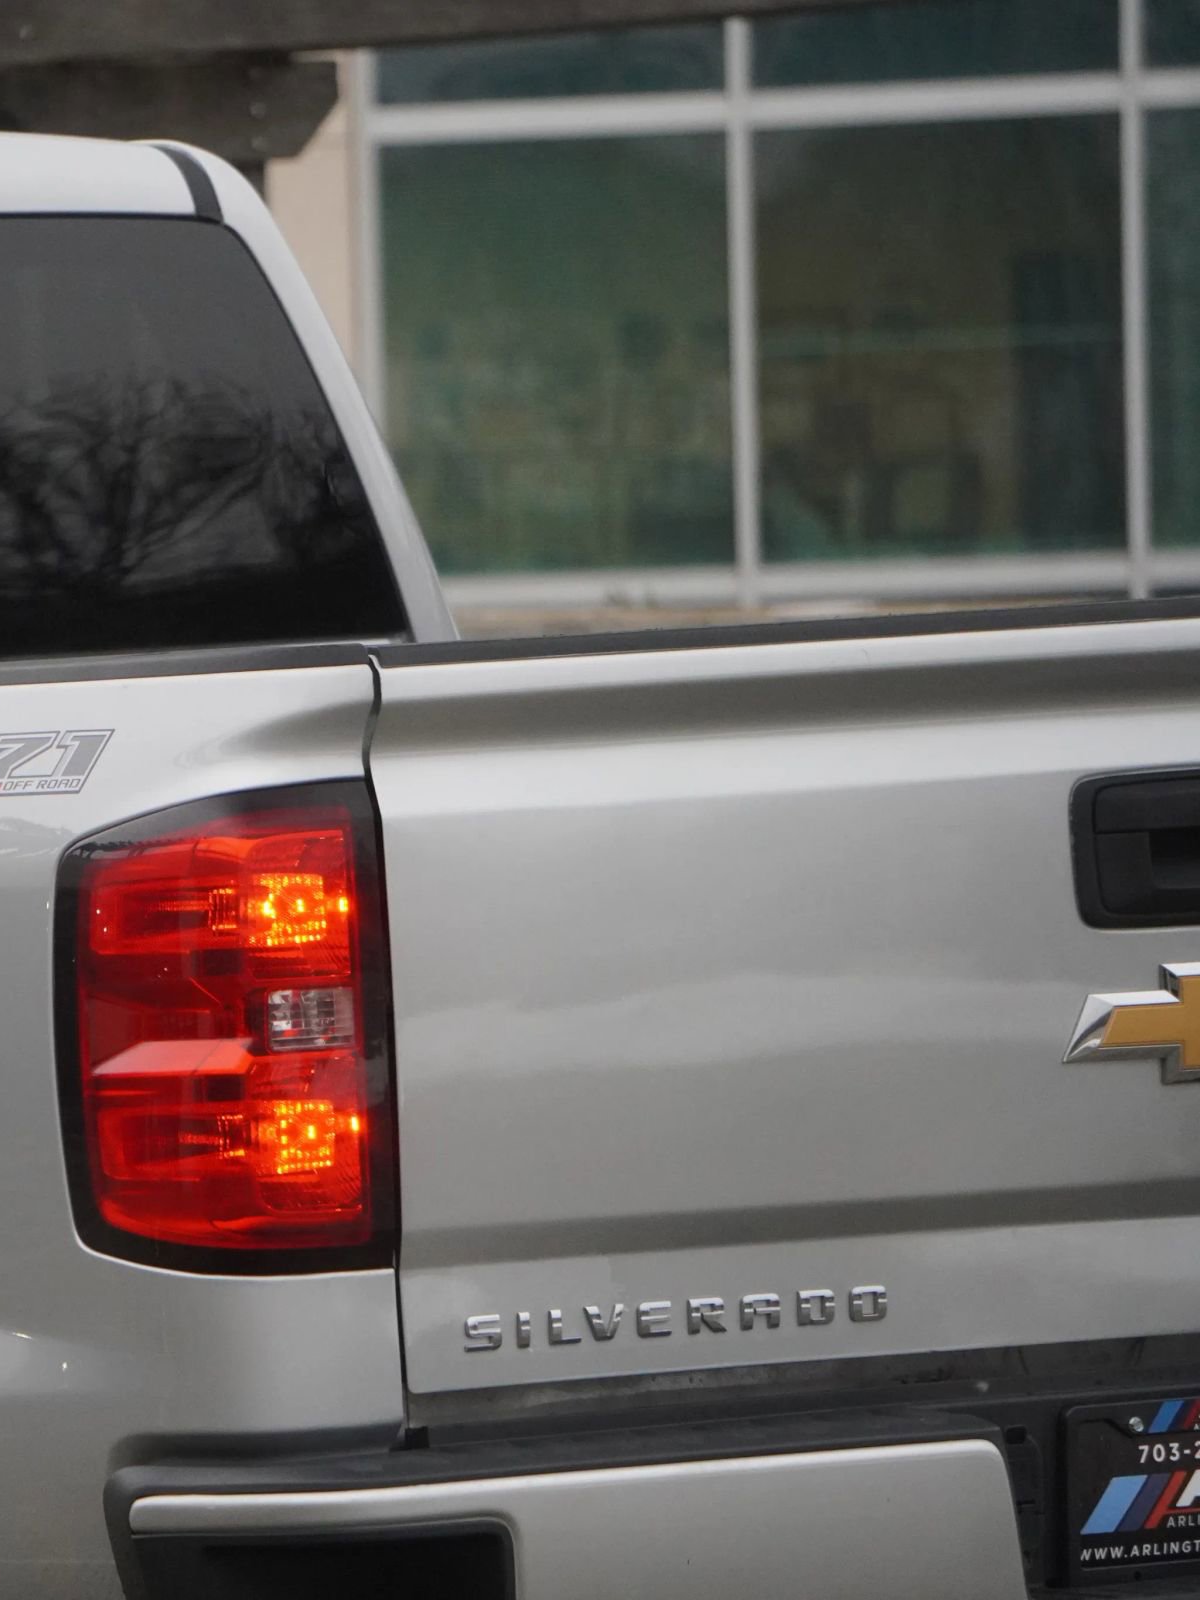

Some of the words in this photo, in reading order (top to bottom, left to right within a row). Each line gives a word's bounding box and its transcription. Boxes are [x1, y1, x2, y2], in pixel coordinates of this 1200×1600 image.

[3, 780, 34, 791] OFF
[36, 778, 81, 790] ROAD
[464, 1285, 888, 1353] SILVERADO
